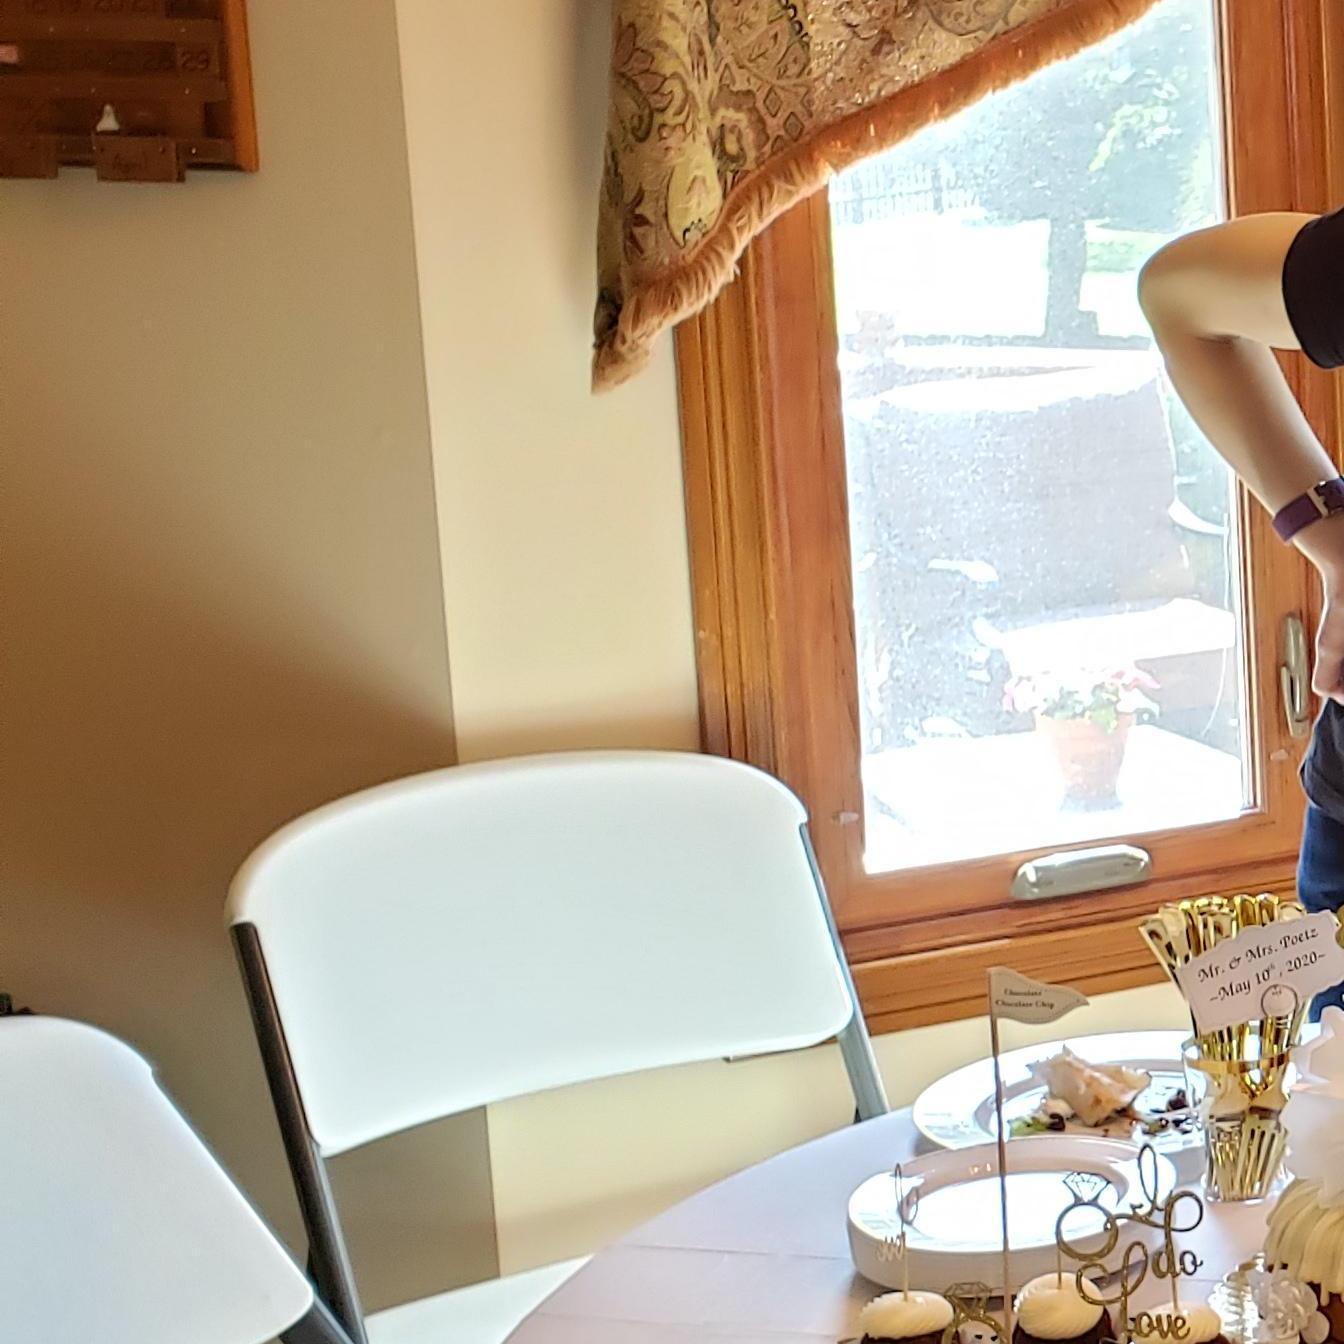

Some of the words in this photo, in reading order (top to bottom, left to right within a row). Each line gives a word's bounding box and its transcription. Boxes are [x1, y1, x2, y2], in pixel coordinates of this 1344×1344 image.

[1197, 962, 1225, 983] Mr.
[1229, 956, 1242, 970] &
[1245, 943, 1278, 964] Mrs.
[1280, 927, 1319, 950] Poetz
[1076, 1241, 1192, 1342] Love
